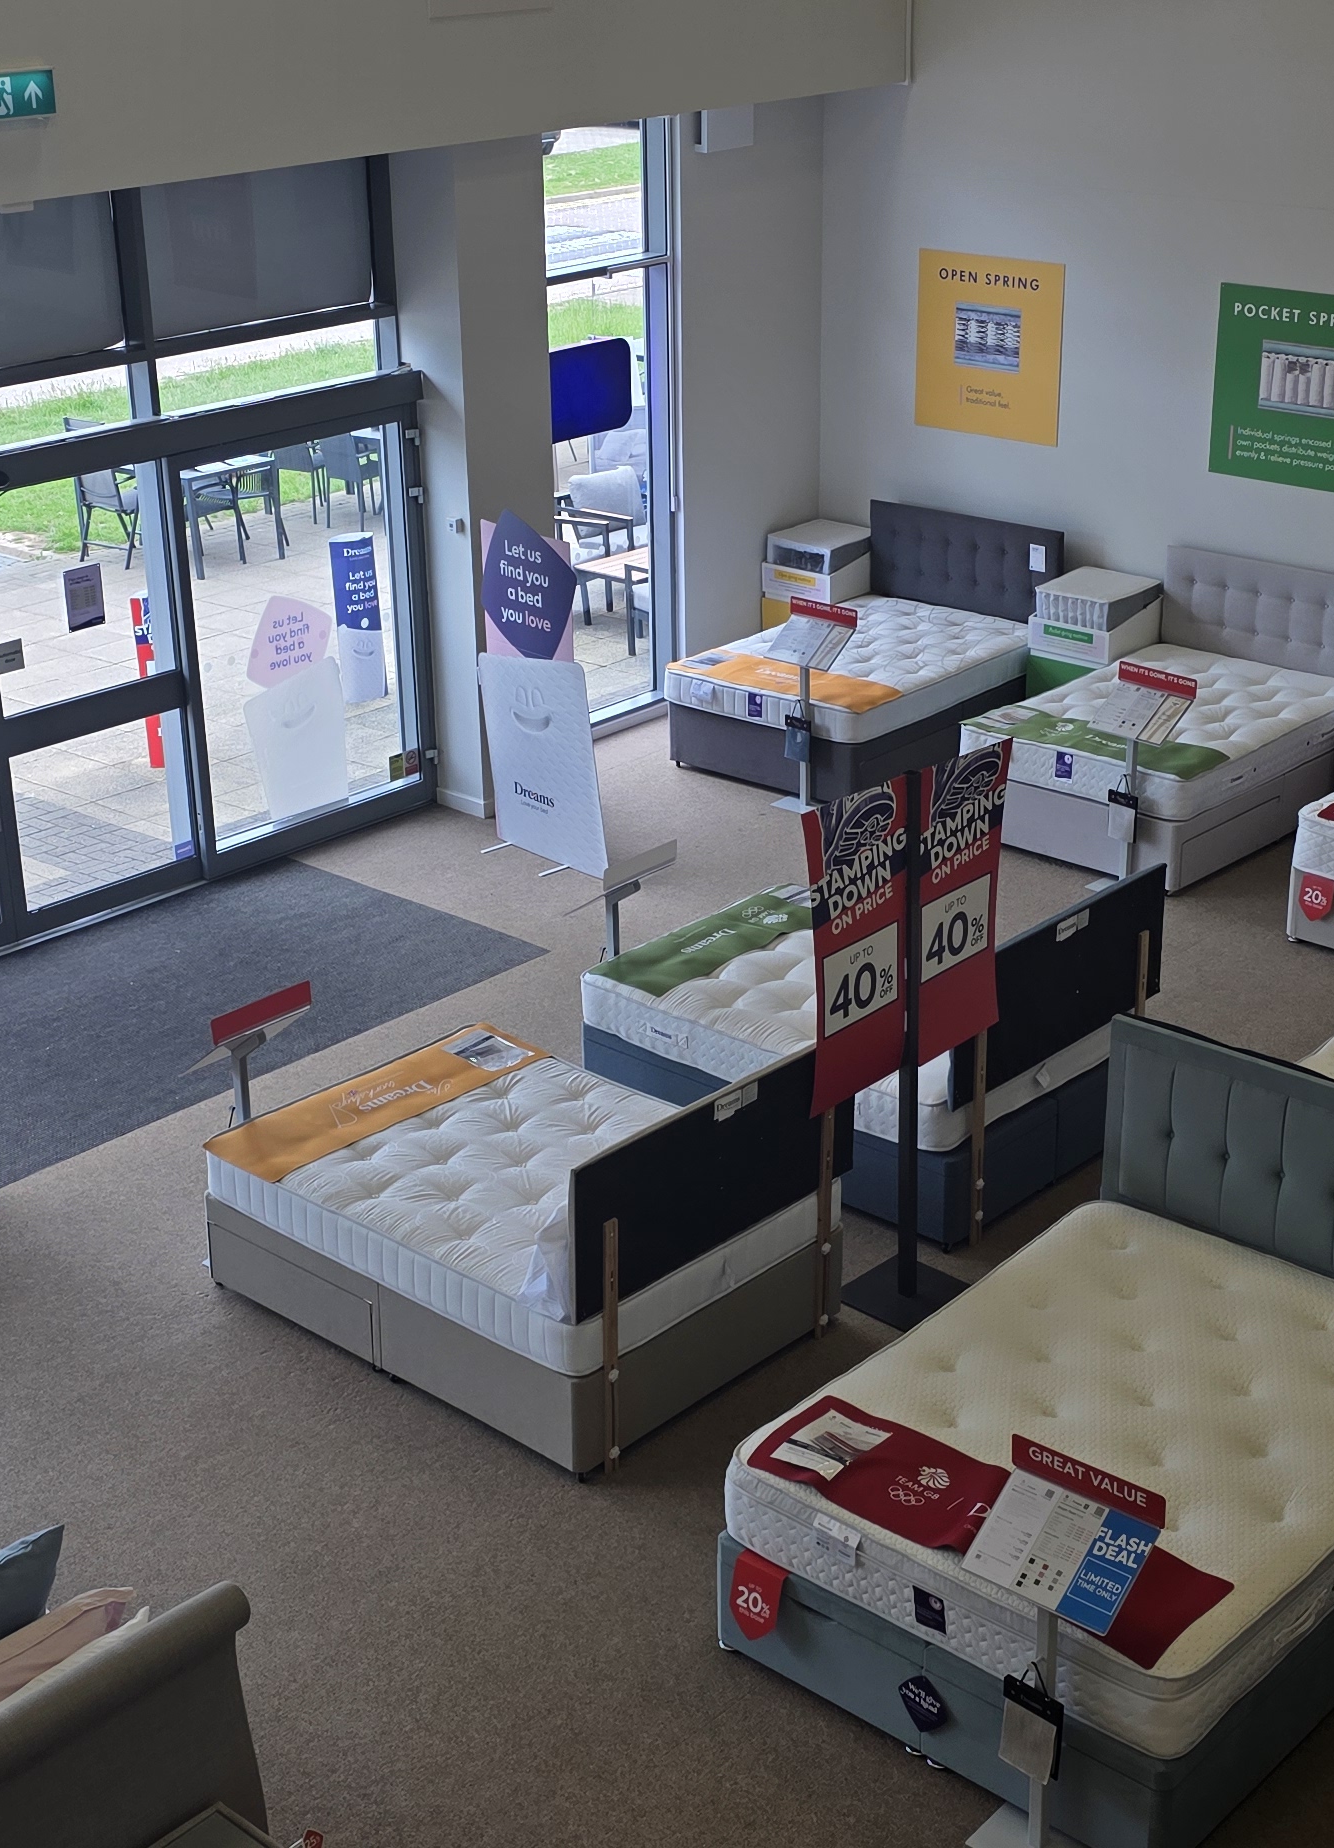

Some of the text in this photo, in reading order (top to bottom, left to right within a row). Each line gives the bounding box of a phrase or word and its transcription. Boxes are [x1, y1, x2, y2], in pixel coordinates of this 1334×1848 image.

[939, 268, 1039, 291] OPEN SPRING
[1234, 302, 1301, 323] POCKET
[1236, 440, 1252, 448] own
[1253, 440, 1280, 452] pockets
[1282, 444, 1315, 457] distribute
[1237, 427, 1272, 440] Individual
[1274, 431, 1299, 445] springs
[1301, 436, 1332, 449] encased
[1235, 449, 1258, 460] evenly
[1268, 453, 1291, 464] relieve
[1292, 458, 1323, 470] pressure
[504, 539, 542, 564] Let us
[345, 581, 364, 591] find
[349, 569, 373, 580] Let us
[500, 559, 549, 588] find you
[359, 589, 374, 600] bed
[507, 586, 542, 608] a bed
[347, 603, 364, 614] you
[501, 606, 551, 632] you love
[1120, 663, 1196, 688] WHEN IT'S GONE, IT'S GONE
[514, 781, 555, 808] Dreams
[919, 783, 1007, 857] STAMPING
[930, 813, 990, 870] DOWN
[809, 826, 907, 908] STAMPING
[931, 834, 990, 884] ON PRICE
[827, 859, 892, 920] DOWN
[831, 882, 894, 935] ON PRICE
[944, 894, 967, 914] UP TO
[681, 928, 737, 954] Dreams
[970, 932, 985, 948] OFF
[849, 944, 874, 965] UP TO
[879, 979, 894, 999] OFF
[358, 1079, 434, 1112] Dreams
[895, 1475, 940, 1500] TEAM GB
[1028, 1446, 1147, 1508] GREAT VALUE
[1092, 1539, 1138, 1569] DEAL
[1094, 1526, 1153, 1557] FLASH
[1077, 1578, 1119, 1602] TIME ONLY
[1080, 1568, 1122, 1595] LIMITED
